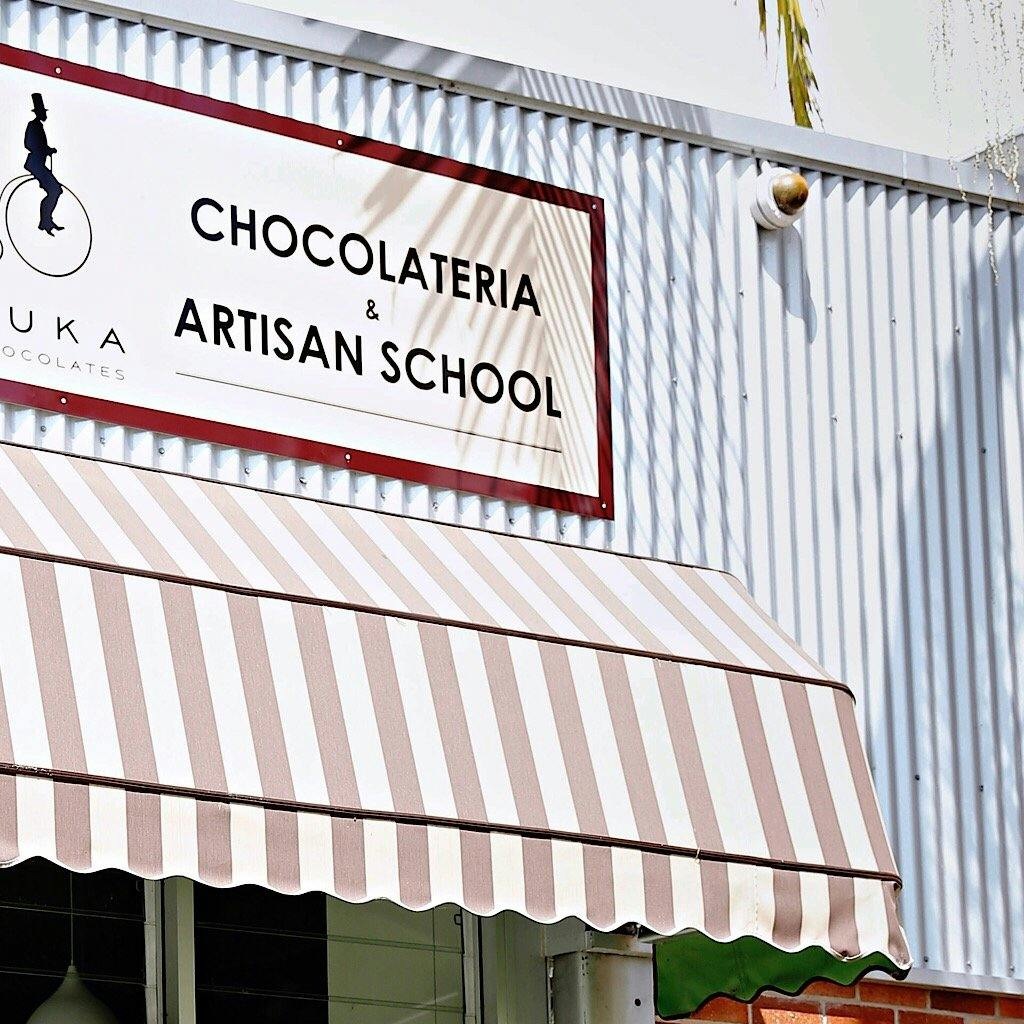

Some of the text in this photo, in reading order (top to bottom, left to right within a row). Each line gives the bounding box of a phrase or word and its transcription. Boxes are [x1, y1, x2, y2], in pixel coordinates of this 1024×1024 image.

[190, 197, 541, 317] CHOCOLATERIA
[365, 299, 380, 321] &
[174, 297, 563, 419] ARTISAN SCHOOL
